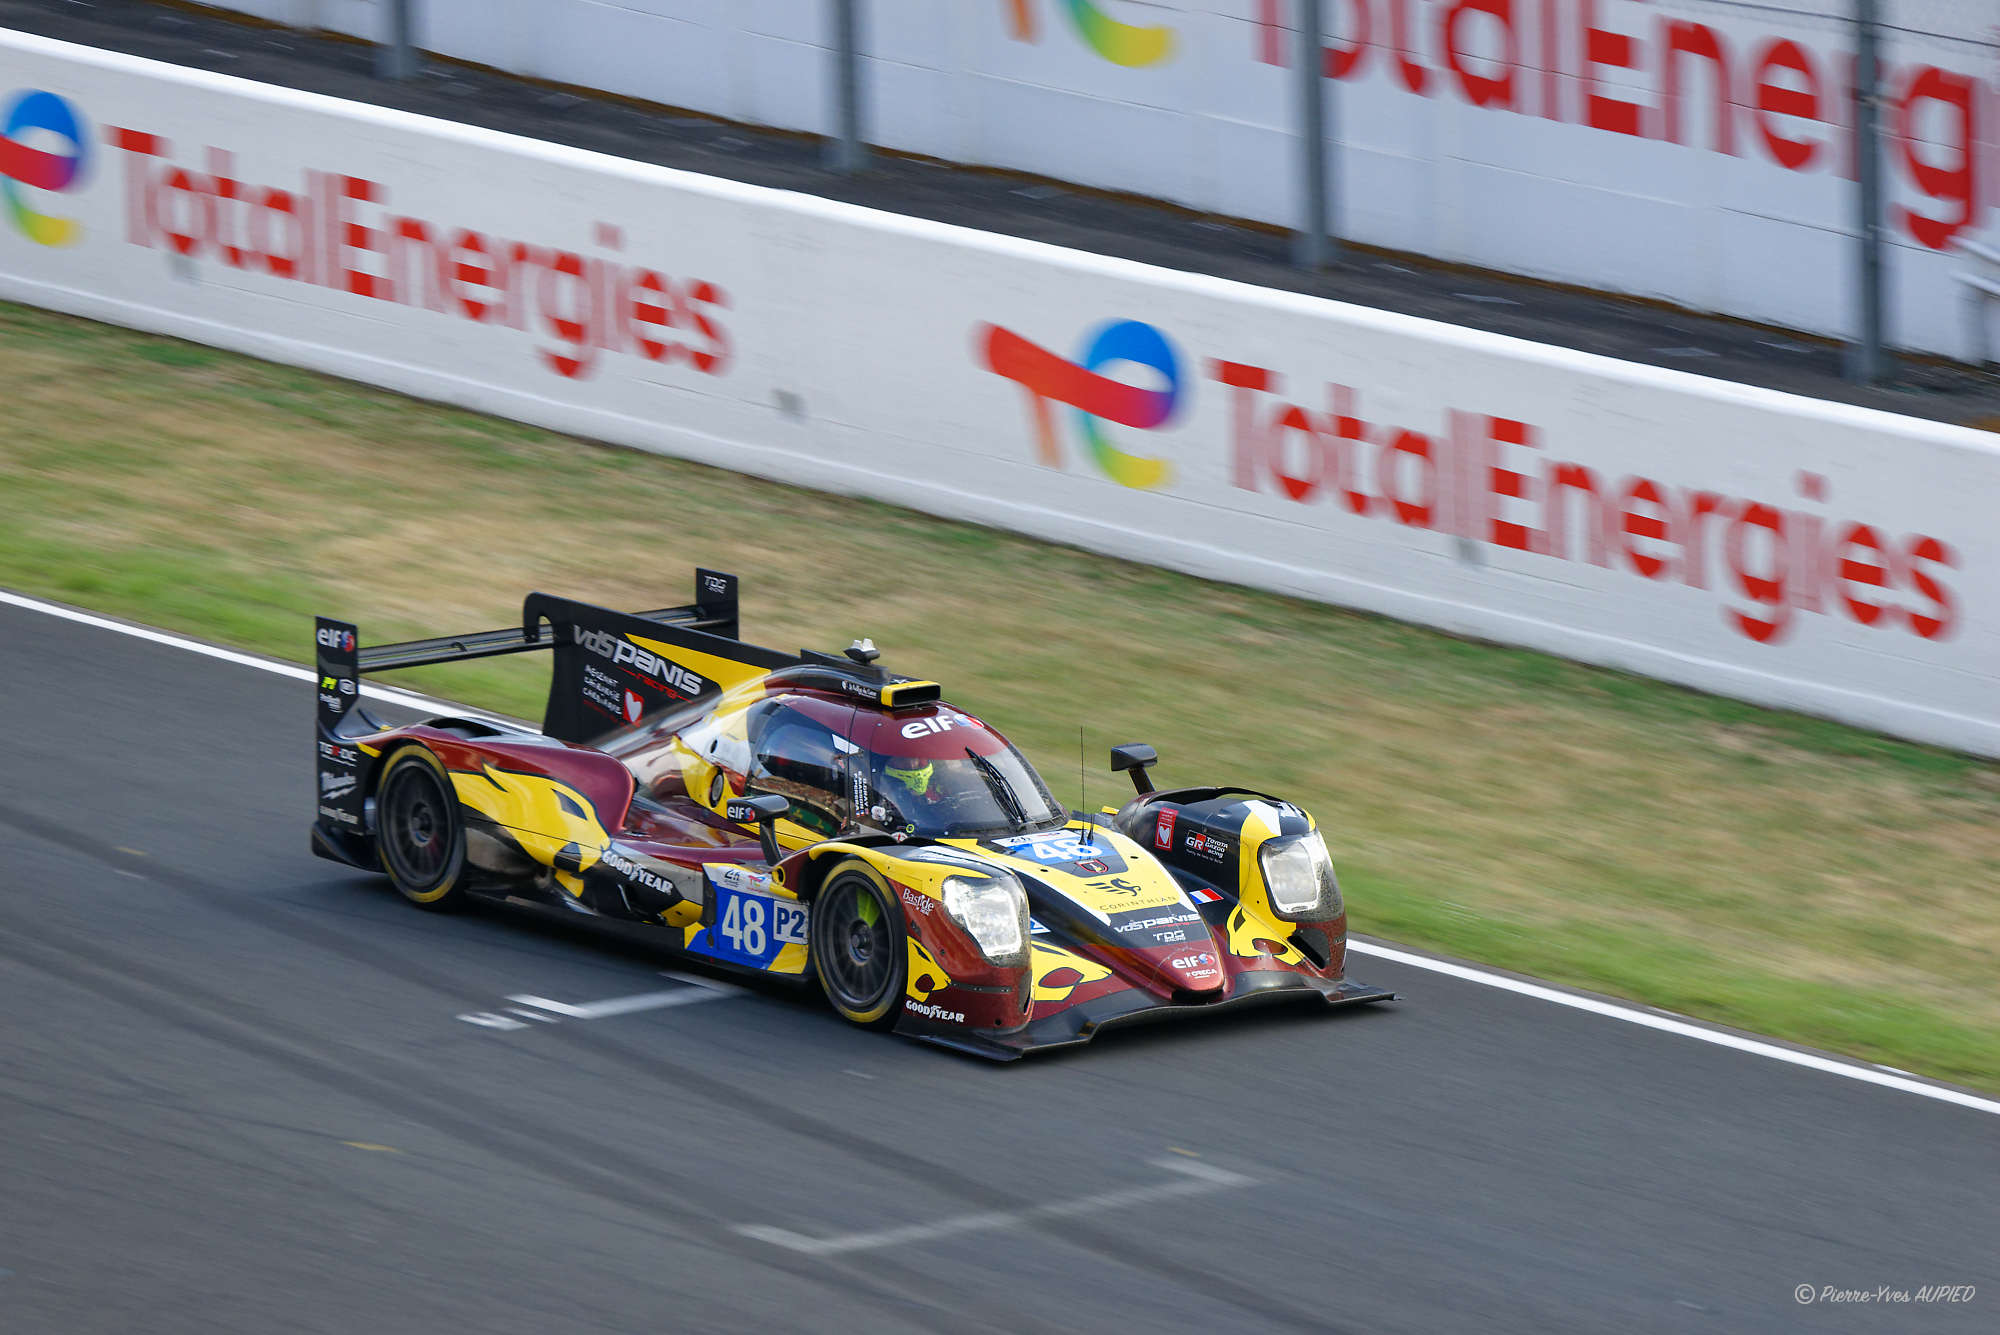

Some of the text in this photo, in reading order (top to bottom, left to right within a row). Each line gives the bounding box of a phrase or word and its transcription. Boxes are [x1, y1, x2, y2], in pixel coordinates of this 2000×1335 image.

[104, 125, 732, 379] TotalEnergies
[1210, 358, 1958, 644] TotalEnergies
[317, 628, 341, 648] elf
[902, 715, 953, 739] elf
[728, 806, 745, 819] elf
[1031, 840, 1102, 860] 48
[1186, 836, 1203, 850] GR
[601, 850, 674, 896] GOODYEAR
[903, 887, 935, 911] Bastide
[1099, 895, 1178, 911] CORINTHIAN
[722, 895, 767, 956] 48
[777, 907, 806, 938] P2
[1172, 954, 1200, 969] elf
[906, 1000, 965, 1023] GOODYEAR
